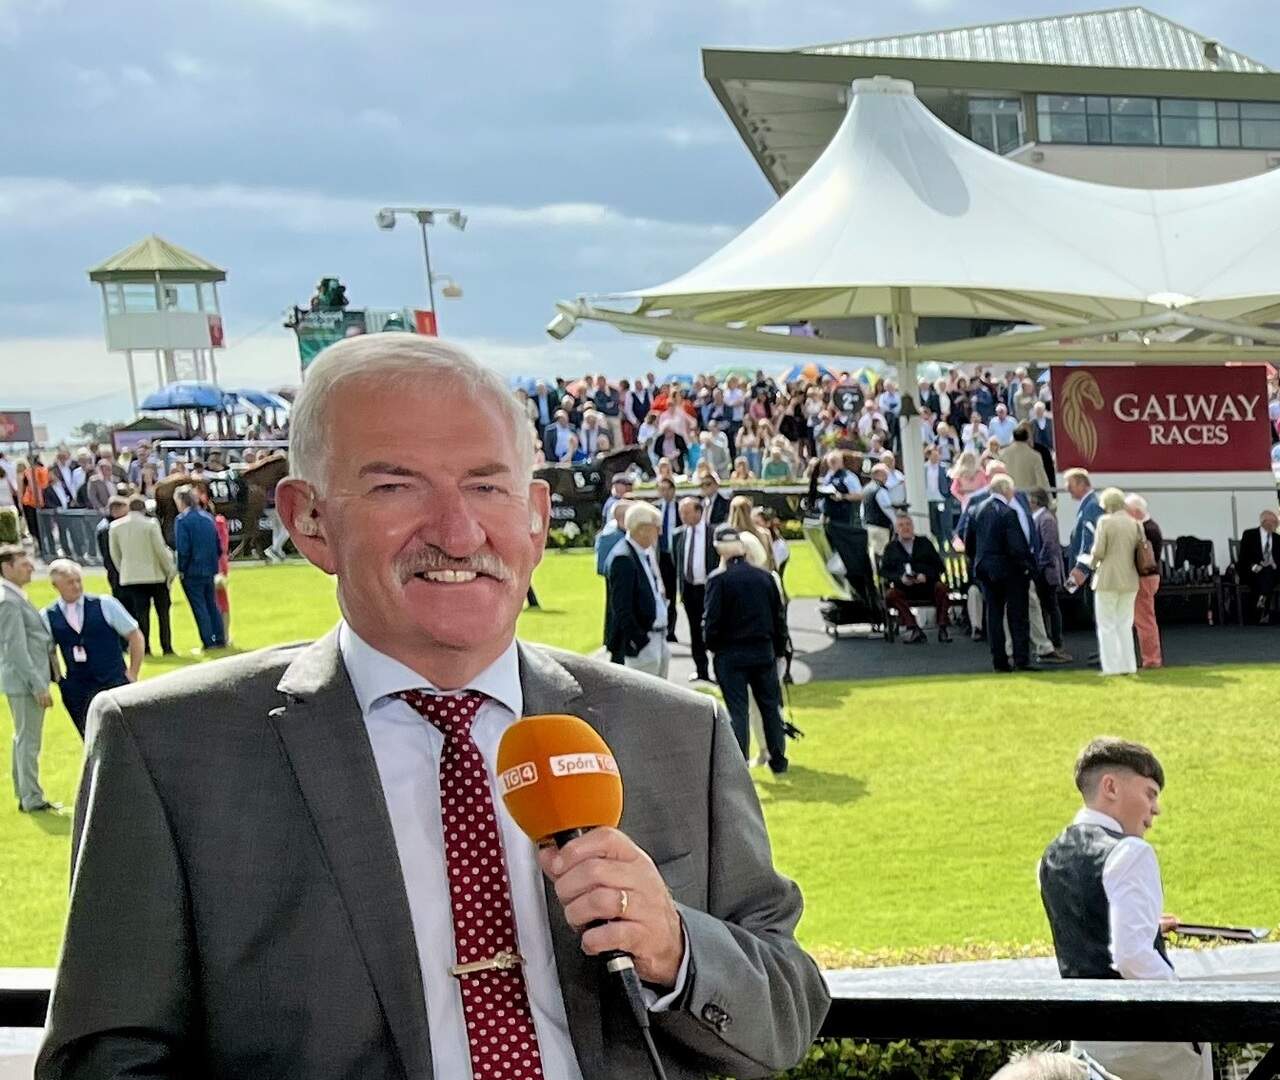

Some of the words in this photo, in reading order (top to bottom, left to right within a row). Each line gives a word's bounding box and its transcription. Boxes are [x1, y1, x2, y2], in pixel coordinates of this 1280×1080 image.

[1113, 393, 1260, 422] GALWAY
[1149, 424, 1229, 446] RACES
[557, 757, 595, 773] Spórt
